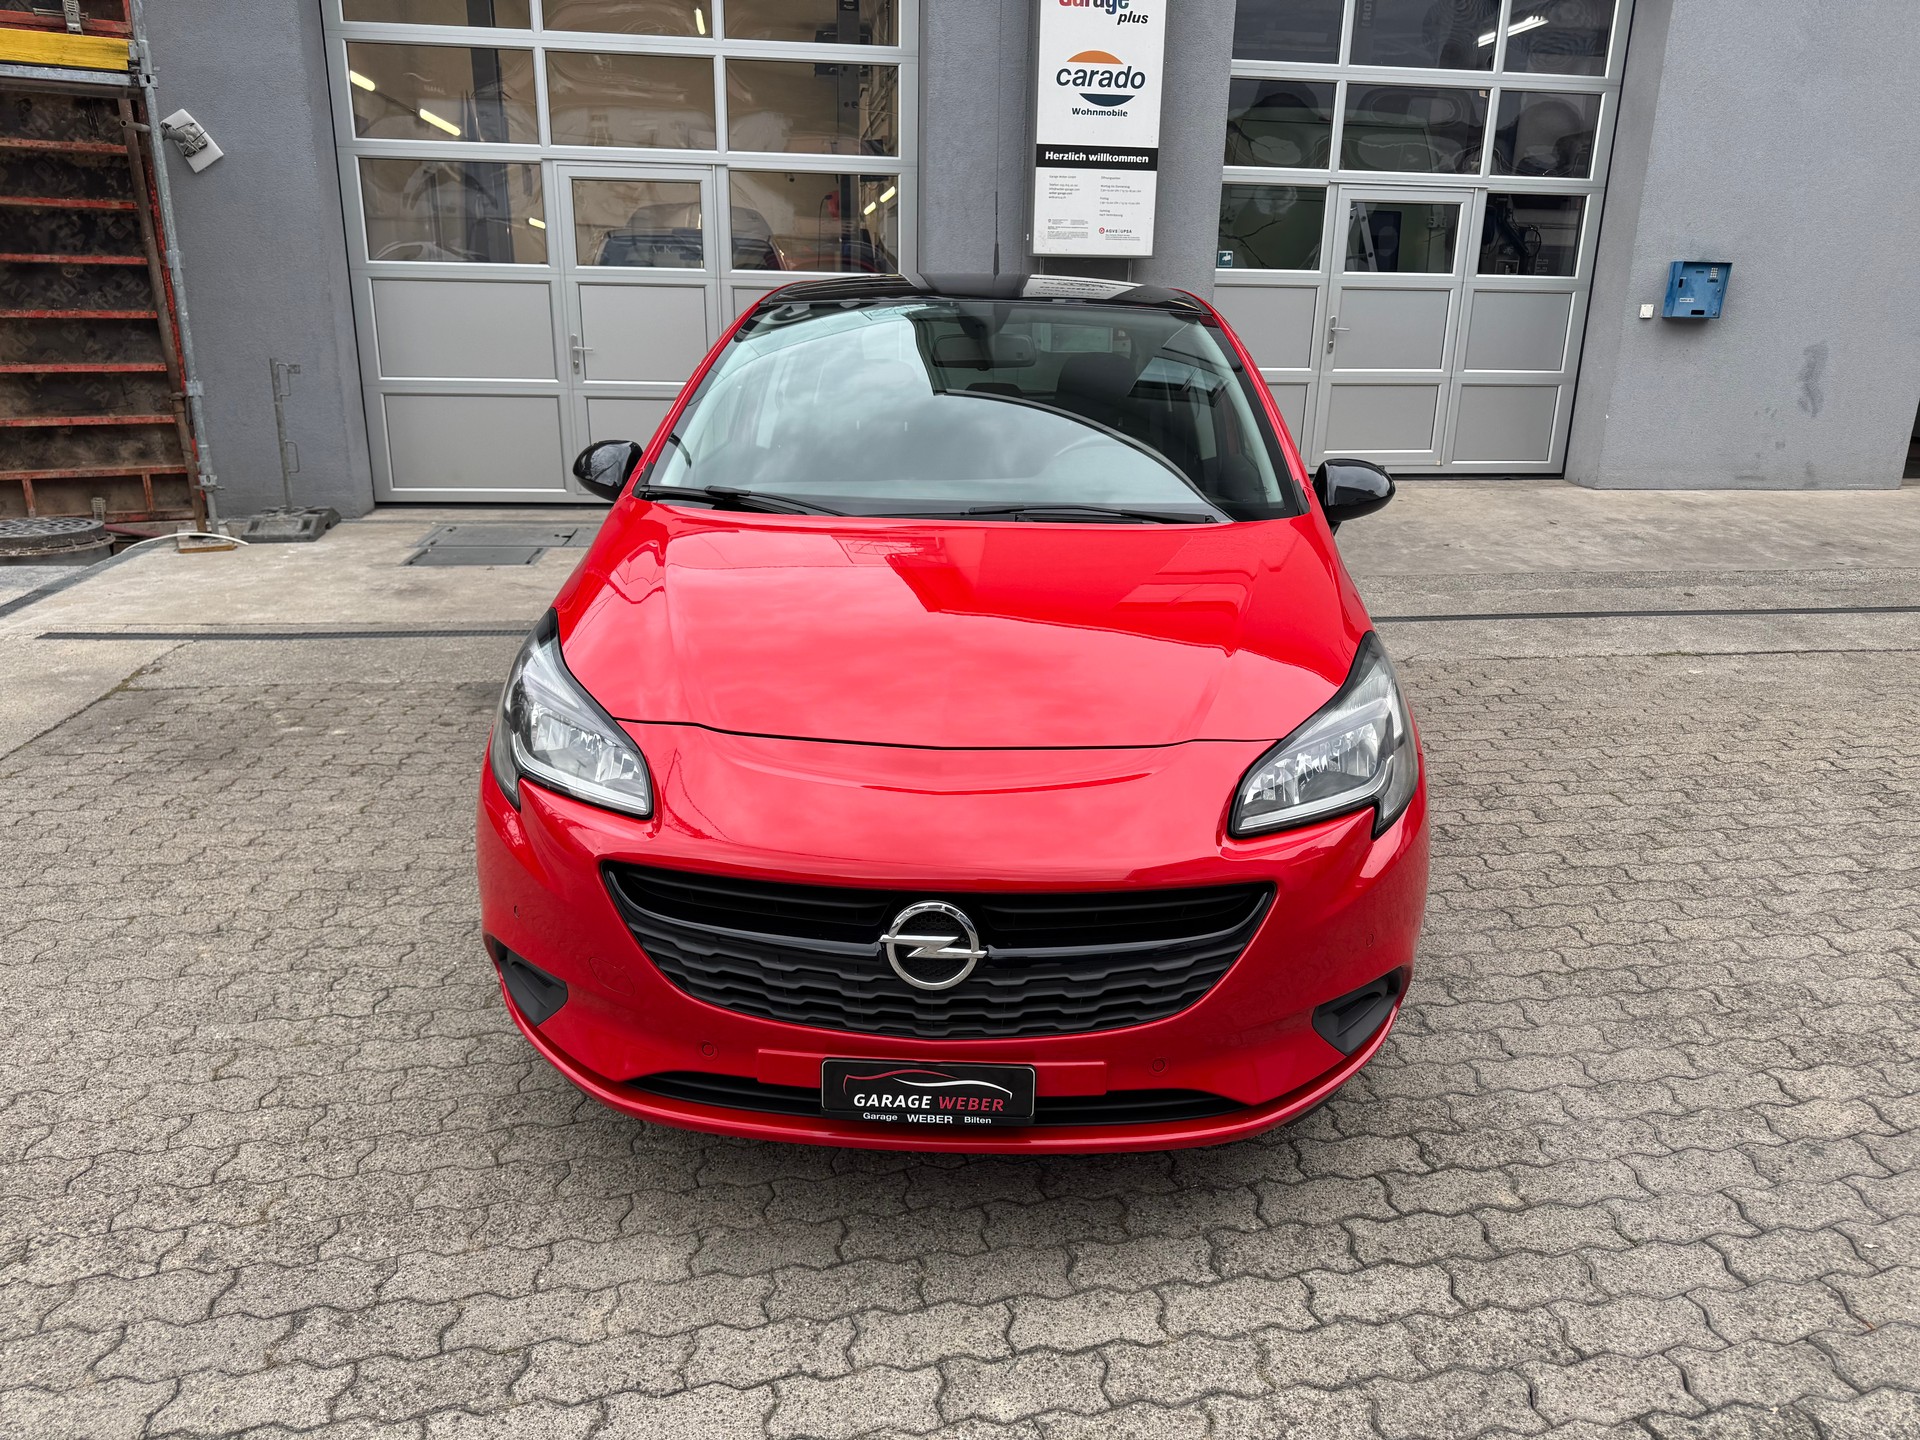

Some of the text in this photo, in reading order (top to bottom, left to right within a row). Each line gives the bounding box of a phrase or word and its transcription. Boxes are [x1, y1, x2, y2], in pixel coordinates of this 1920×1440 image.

[1117, 10, 1149, 25] plus
[1056, 66, 1146, 89] carado
[1072, 107, 1128, 117] Wohnmobile
[1045, 151, 1149, 163] Herzlich willkommen
[853, 1093, 1004, 1112] GARAGE WEBER
[862, 1112, 992, 1124] Garage WEBER Bilten
